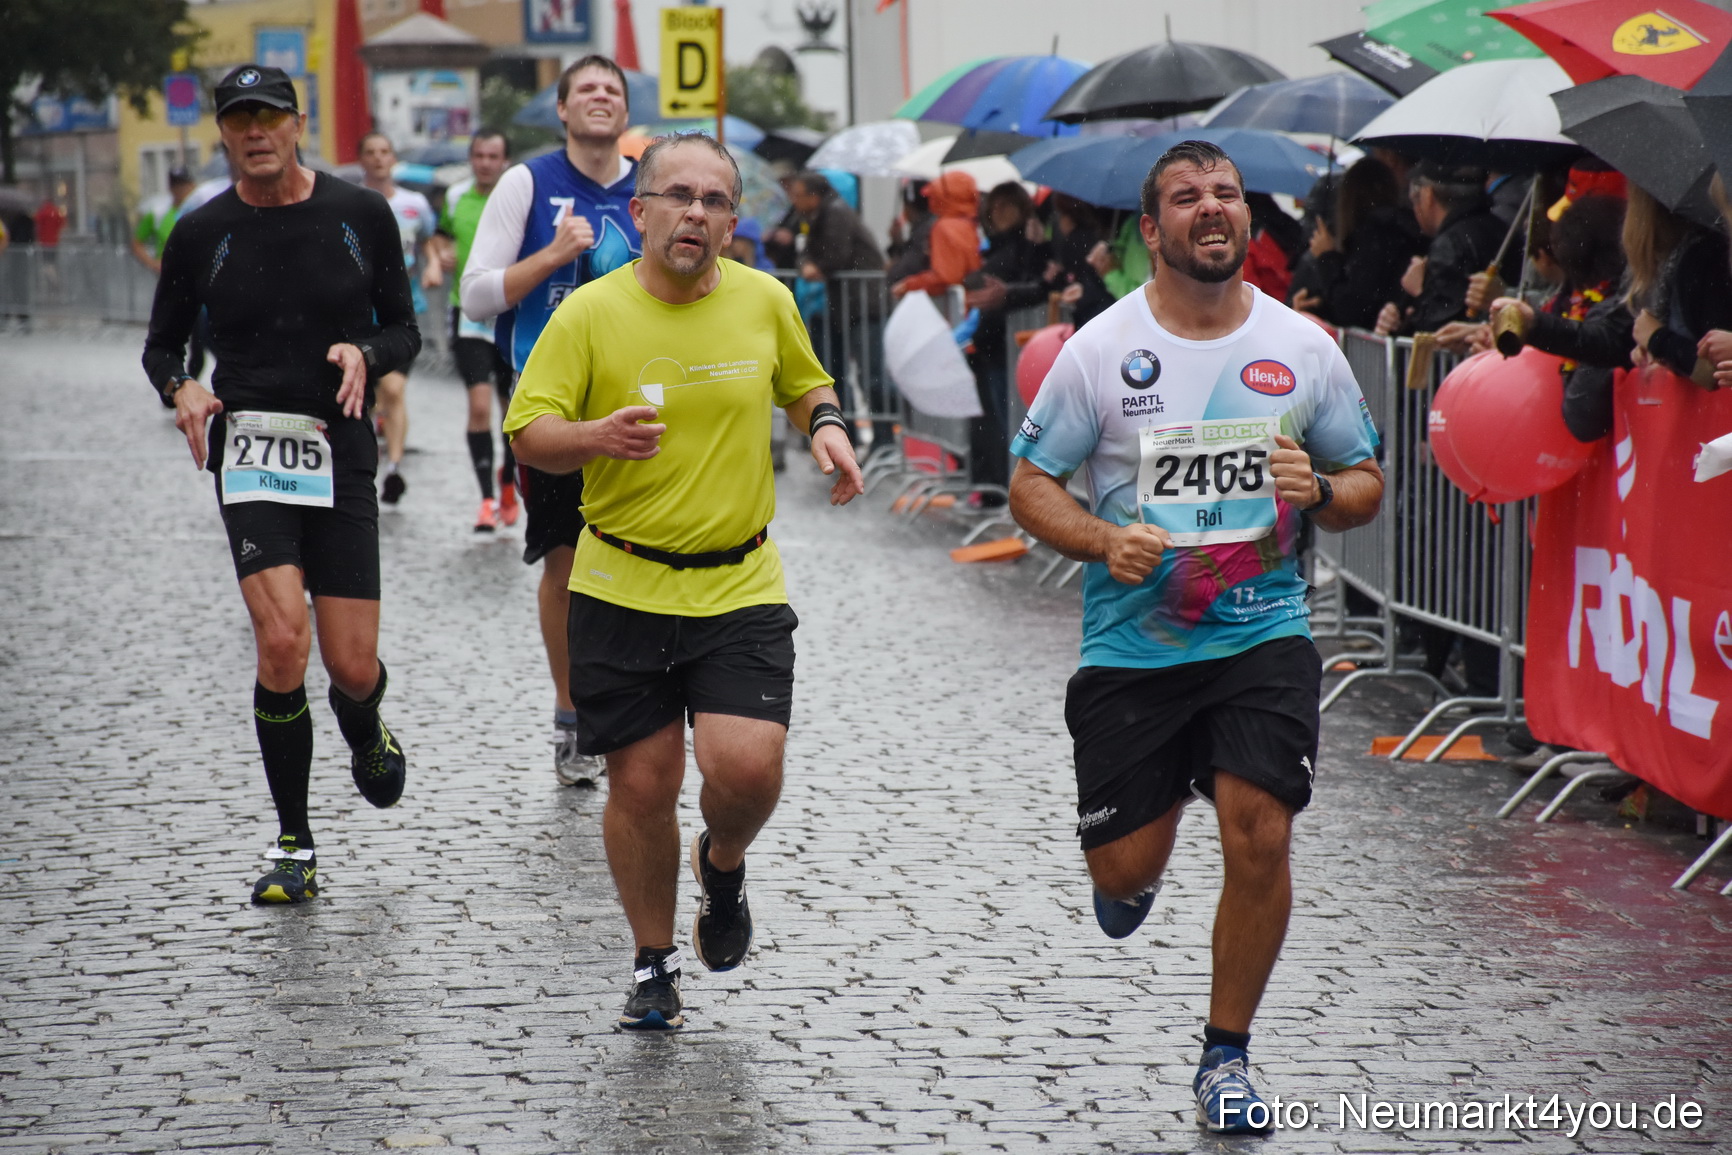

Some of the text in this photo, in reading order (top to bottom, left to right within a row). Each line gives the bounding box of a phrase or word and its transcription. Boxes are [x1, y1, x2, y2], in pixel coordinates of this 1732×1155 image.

[666, 11, 716, 31] Block
[678, 41, 708, 90] D
[549, 197, 576, 227] 7
[1124, 350, 1157, 364] BMW
[689, 364, 716, 372] Kliniken
[709, 368, 740, 377] Neumarkt
[1248, 368, 1291, 388] Hervis
[1122, 394, 1164, 409] PARTL
[1122, 405, 1164, 418] Neumarkt
[1202, 422, 1269, 441] BOCK
[234, 434, 323, 471] 2705
[1153, 450, 1267, 497] 2465
[259, 475, 297, 492] Klaus
[1144, 494, 1149, 502] D
[1196, 507, 1222, 527] Roi
